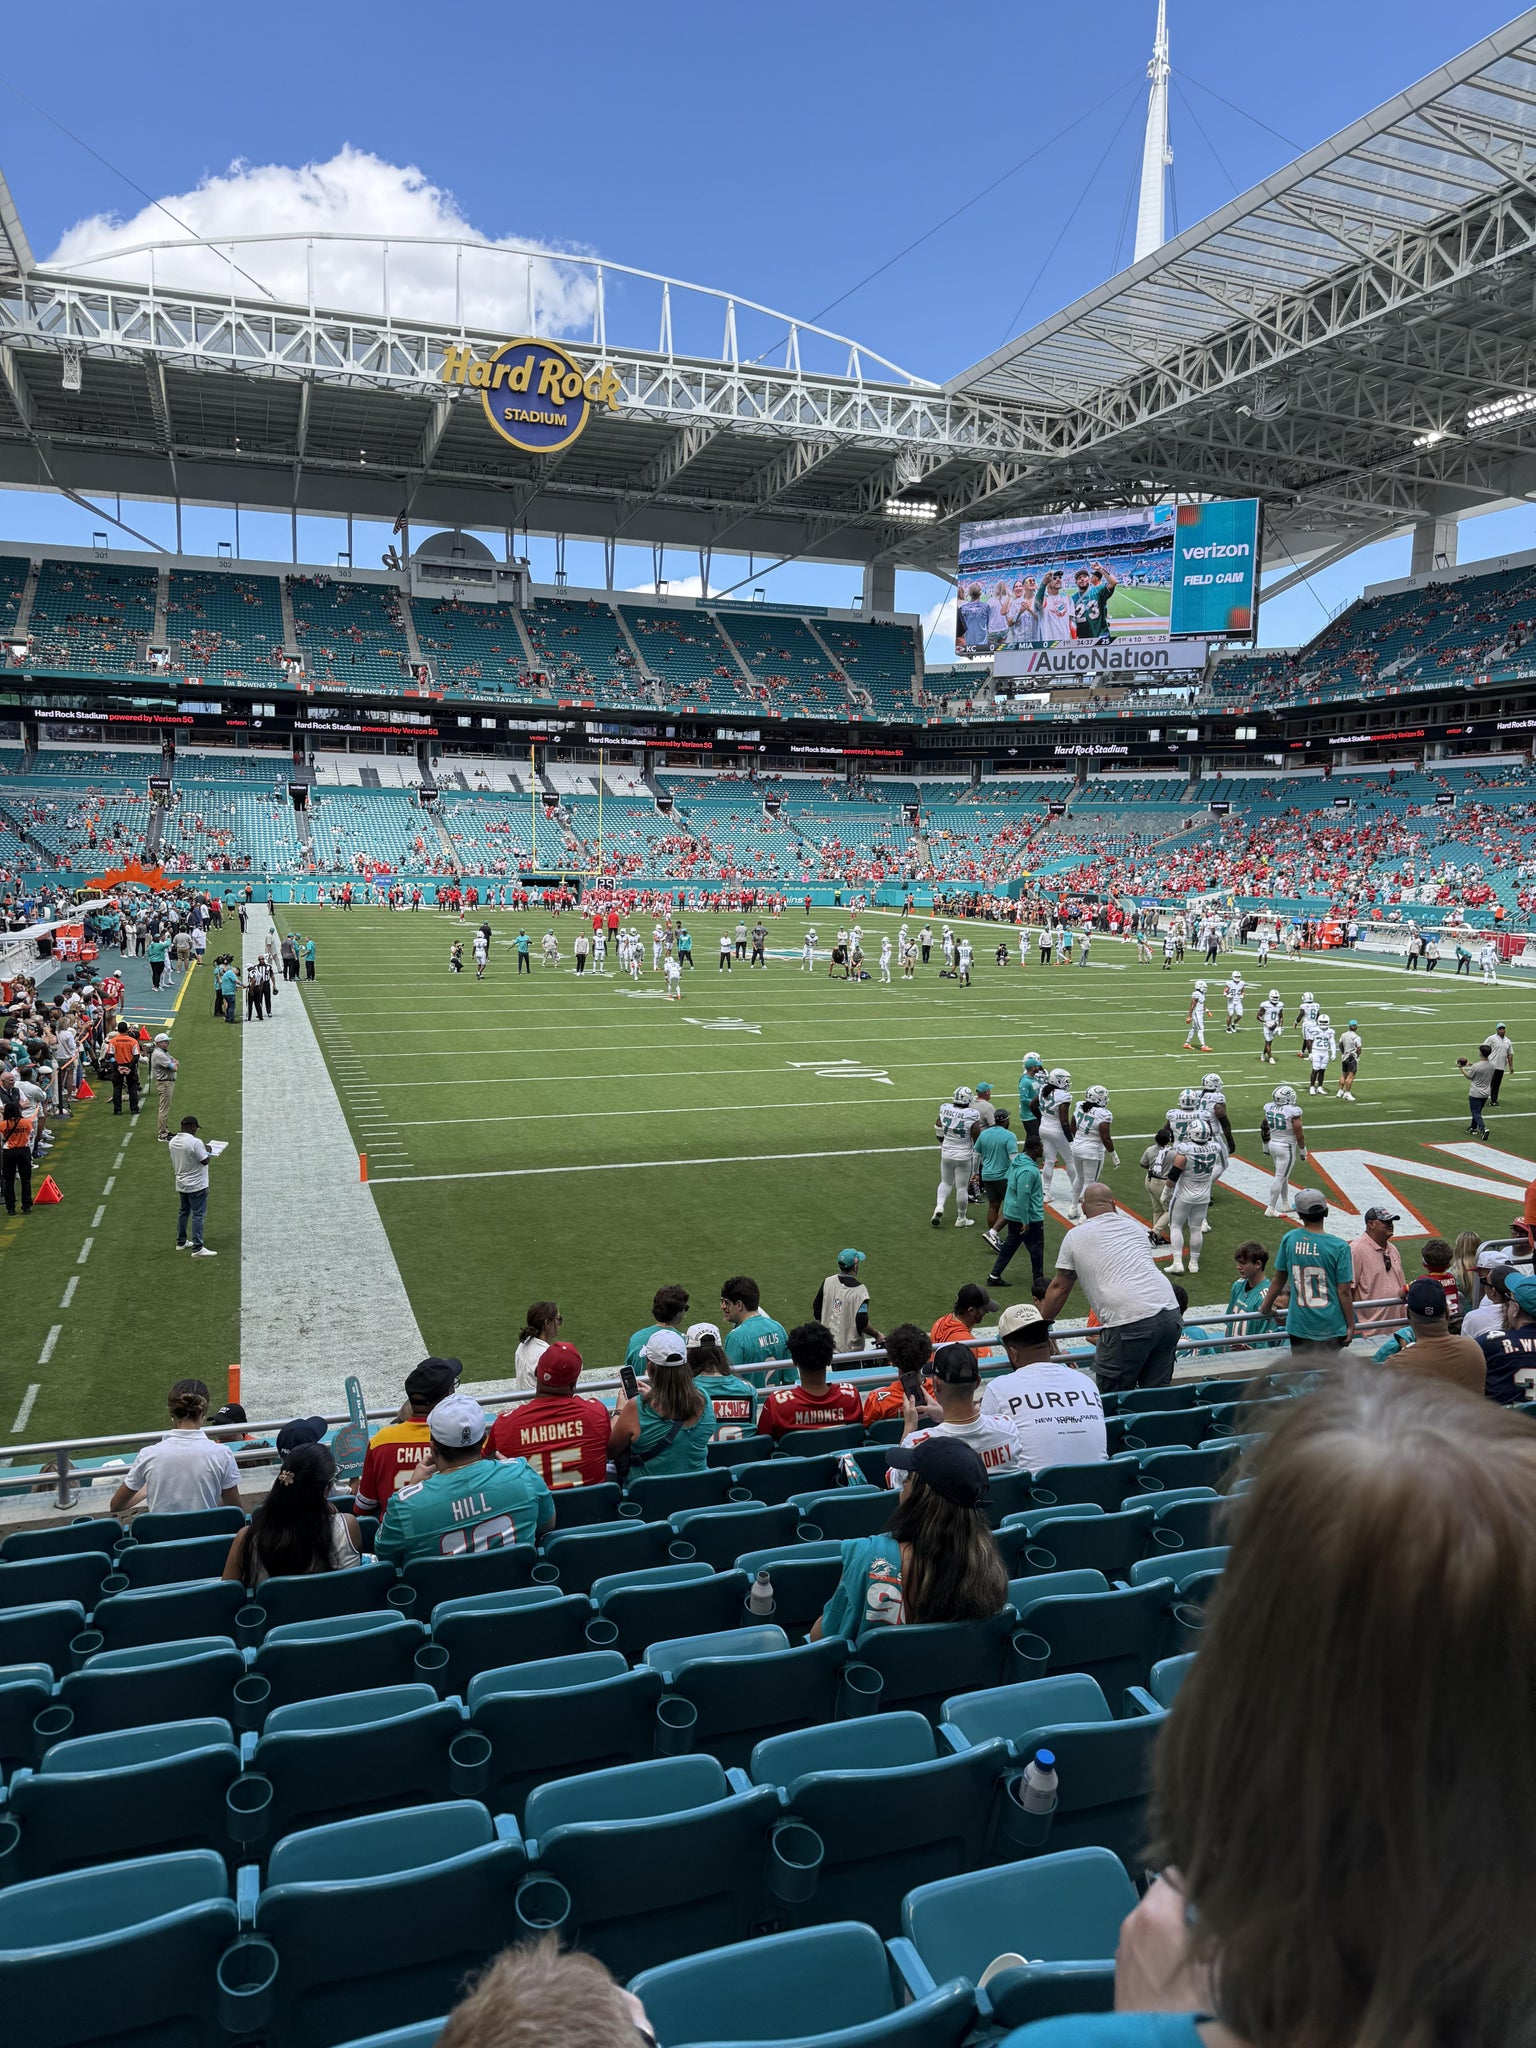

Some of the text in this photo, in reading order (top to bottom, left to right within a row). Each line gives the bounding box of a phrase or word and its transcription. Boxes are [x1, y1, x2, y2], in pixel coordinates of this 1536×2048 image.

[442, 346, 622, 411] Hard Rock
[504, 408, 567, 426] STADIUM
[94, 551, 108, 559] 301
[1182, 542, 1249, 560] verizon
[1497, 558, 1509, 566] 314
[1183, 572, 1244, 586] FIELD CAM
[451, 588, 465, 596] 304
[555, 588, 568, 596] 305
[1075, 600, 1100, 623] 23
[1018, 642, 1034, 650] MIA
[1035, 647, 1169, 672] AutoNation
[1516, 671, 1528, 679] JOE
[222, 679, 237, 687] TIM
[237, 681, 266, 689] BOWENS
[321, 685, 348, 693] MANNY
[349, 686, 387, 695] FERNANDEZ
[1410, 679, 1464, 692] PAUL WARFIELD 42
[471, 694, 533, 705] JASON TAYLOR 99
[612, 702, 630, 710] ZACH
[631, 703, 657, 711] THOMAS
[1169, 709, 1197, 717] CSONKA
[1198, 708, 1209, 716] 39
[34, 709, 194, 724] Hard Rock Stadium powered by Verizon 5G
[1087, 712, 1097, 720] 89
[294, 720, 439, 736] Hard Rock Stadium powered by Verizon 5G
[1496, 720, 1526, 730] Hard Rock
[588, 736, 605, 744] Hard
[604, 737, 621, 745] Rock
[621, 738, 647, 746] Stadium
[646, 740, 673, 748] powered
[673, 740, 681, 749] by
[1328, 736, 1341, 745] Hard
[1341, 735, 1351, 744] Rock
[1351, 735, 1371, 743] Stadium
[1370, 733, 1392, 743] powered
[1398, 731, 1417, 739] Verizon
[790, 745, 805, 753] Hard
[804, 746, 819, 754] Rock
[819, 746, 843, 755] Stadium
[843, 748, 867, 756] powered
[1054, 744, 1129, 756] Hard Rock Stadium
[599, 879, 613, 889] 25
[1270, 1011, 1277, 1021] 0
[1310, 1008, 1316, 1019] 6
[943, 1108, 965, 1120] PROCTOR
[1175, 1113, 1200, 1121] JACKSON
[942, 1117, 966, 1139] 74
[1076, 1112, 1095, 1135] 77
[1295, 1241, 1320, 1257] HILL
[1292, 1265, 1329, 1308] 10
[1008, 1390, 1103, 1416] PURPLE
[795, 1407, 845, 1425] MAHOMES
[1034, 1417, 1053, 1425] NEW
[520, 1420, 584, 1446] MAHOMES
[451, 1492, 492, 1522] HILL
